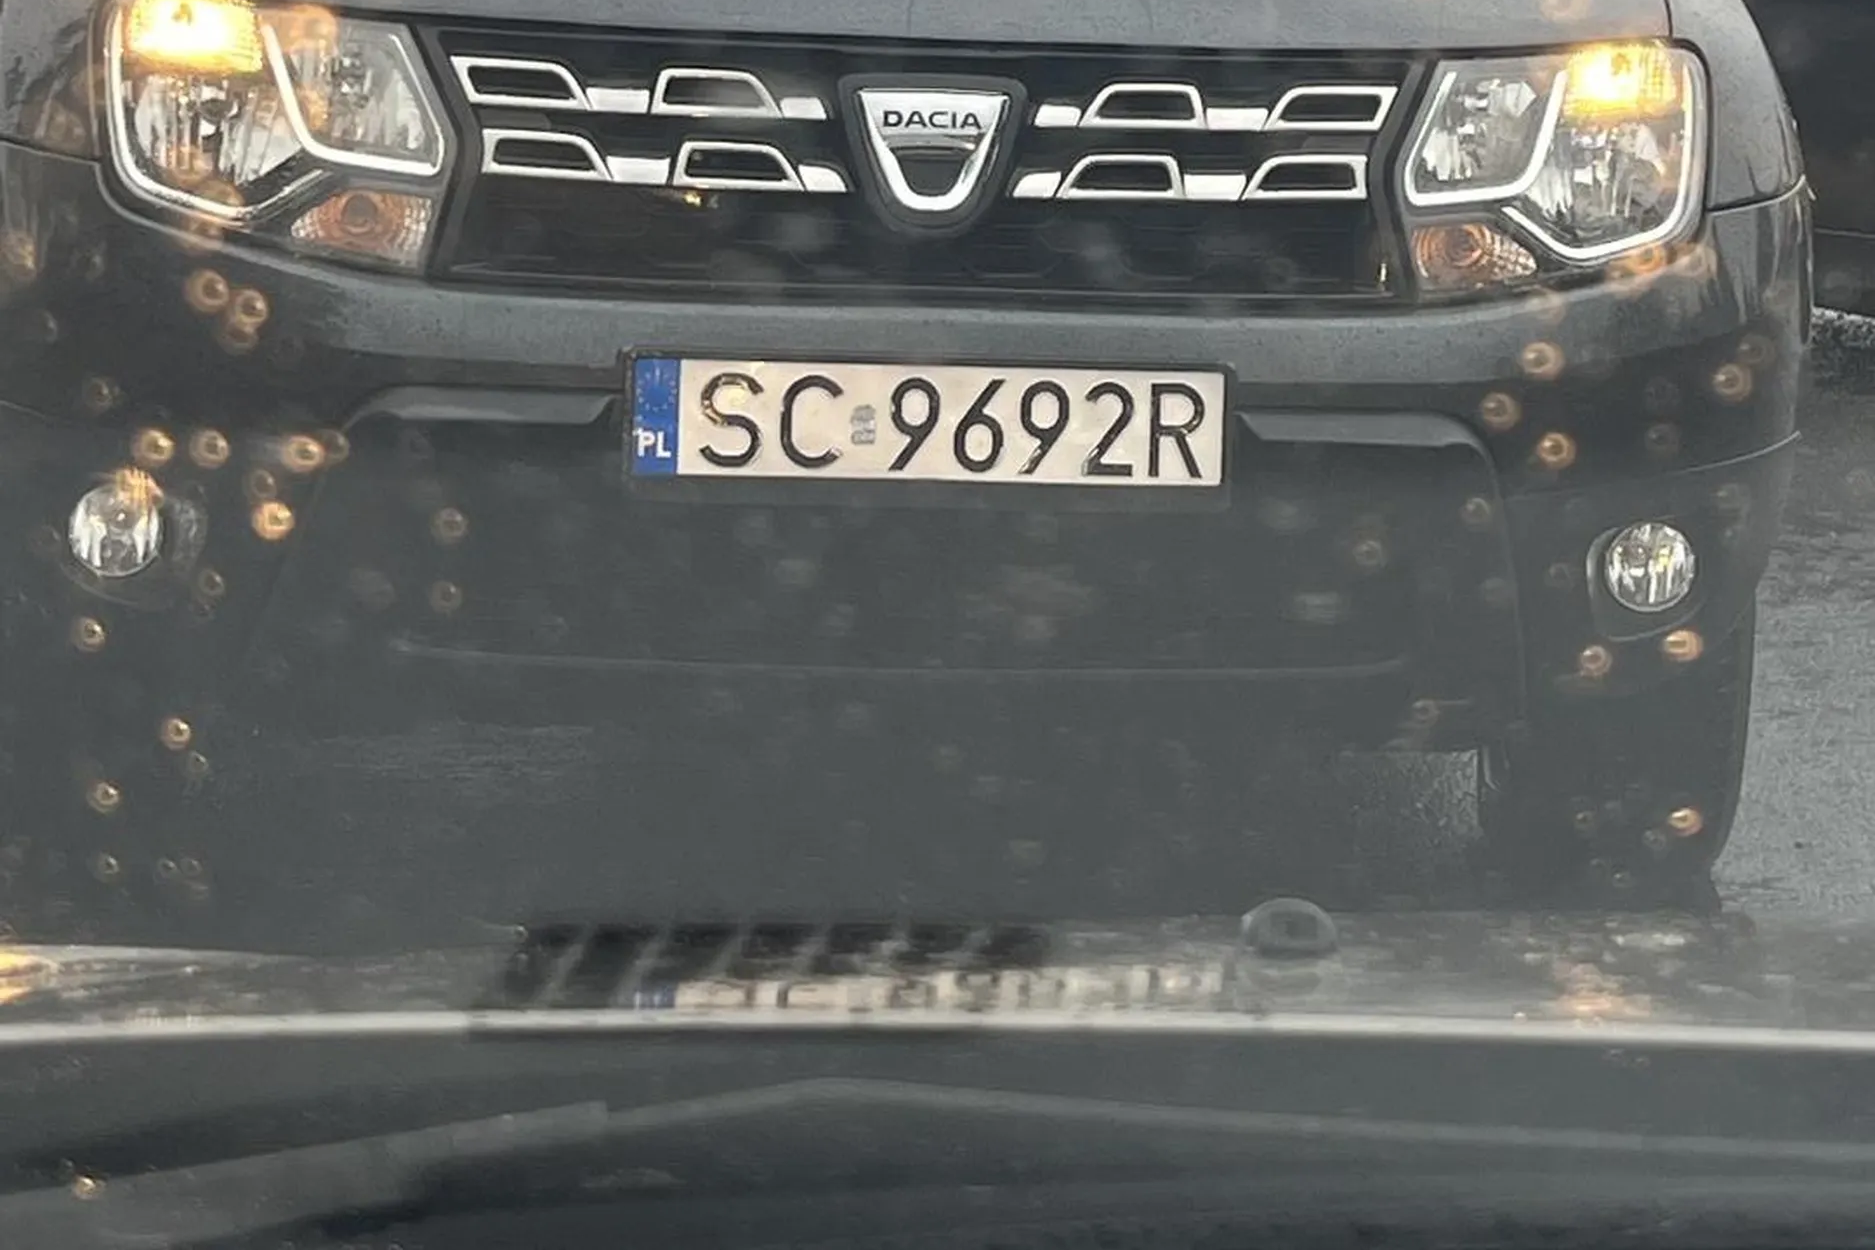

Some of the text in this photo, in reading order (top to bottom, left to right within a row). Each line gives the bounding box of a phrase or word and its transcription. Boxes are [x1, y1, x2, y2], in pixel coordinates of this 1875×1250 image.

[883, 110, 982, 130] DACIA
[699, 372, 1205, 479] SC 9692R
[637, 429, 672, 458] PL
